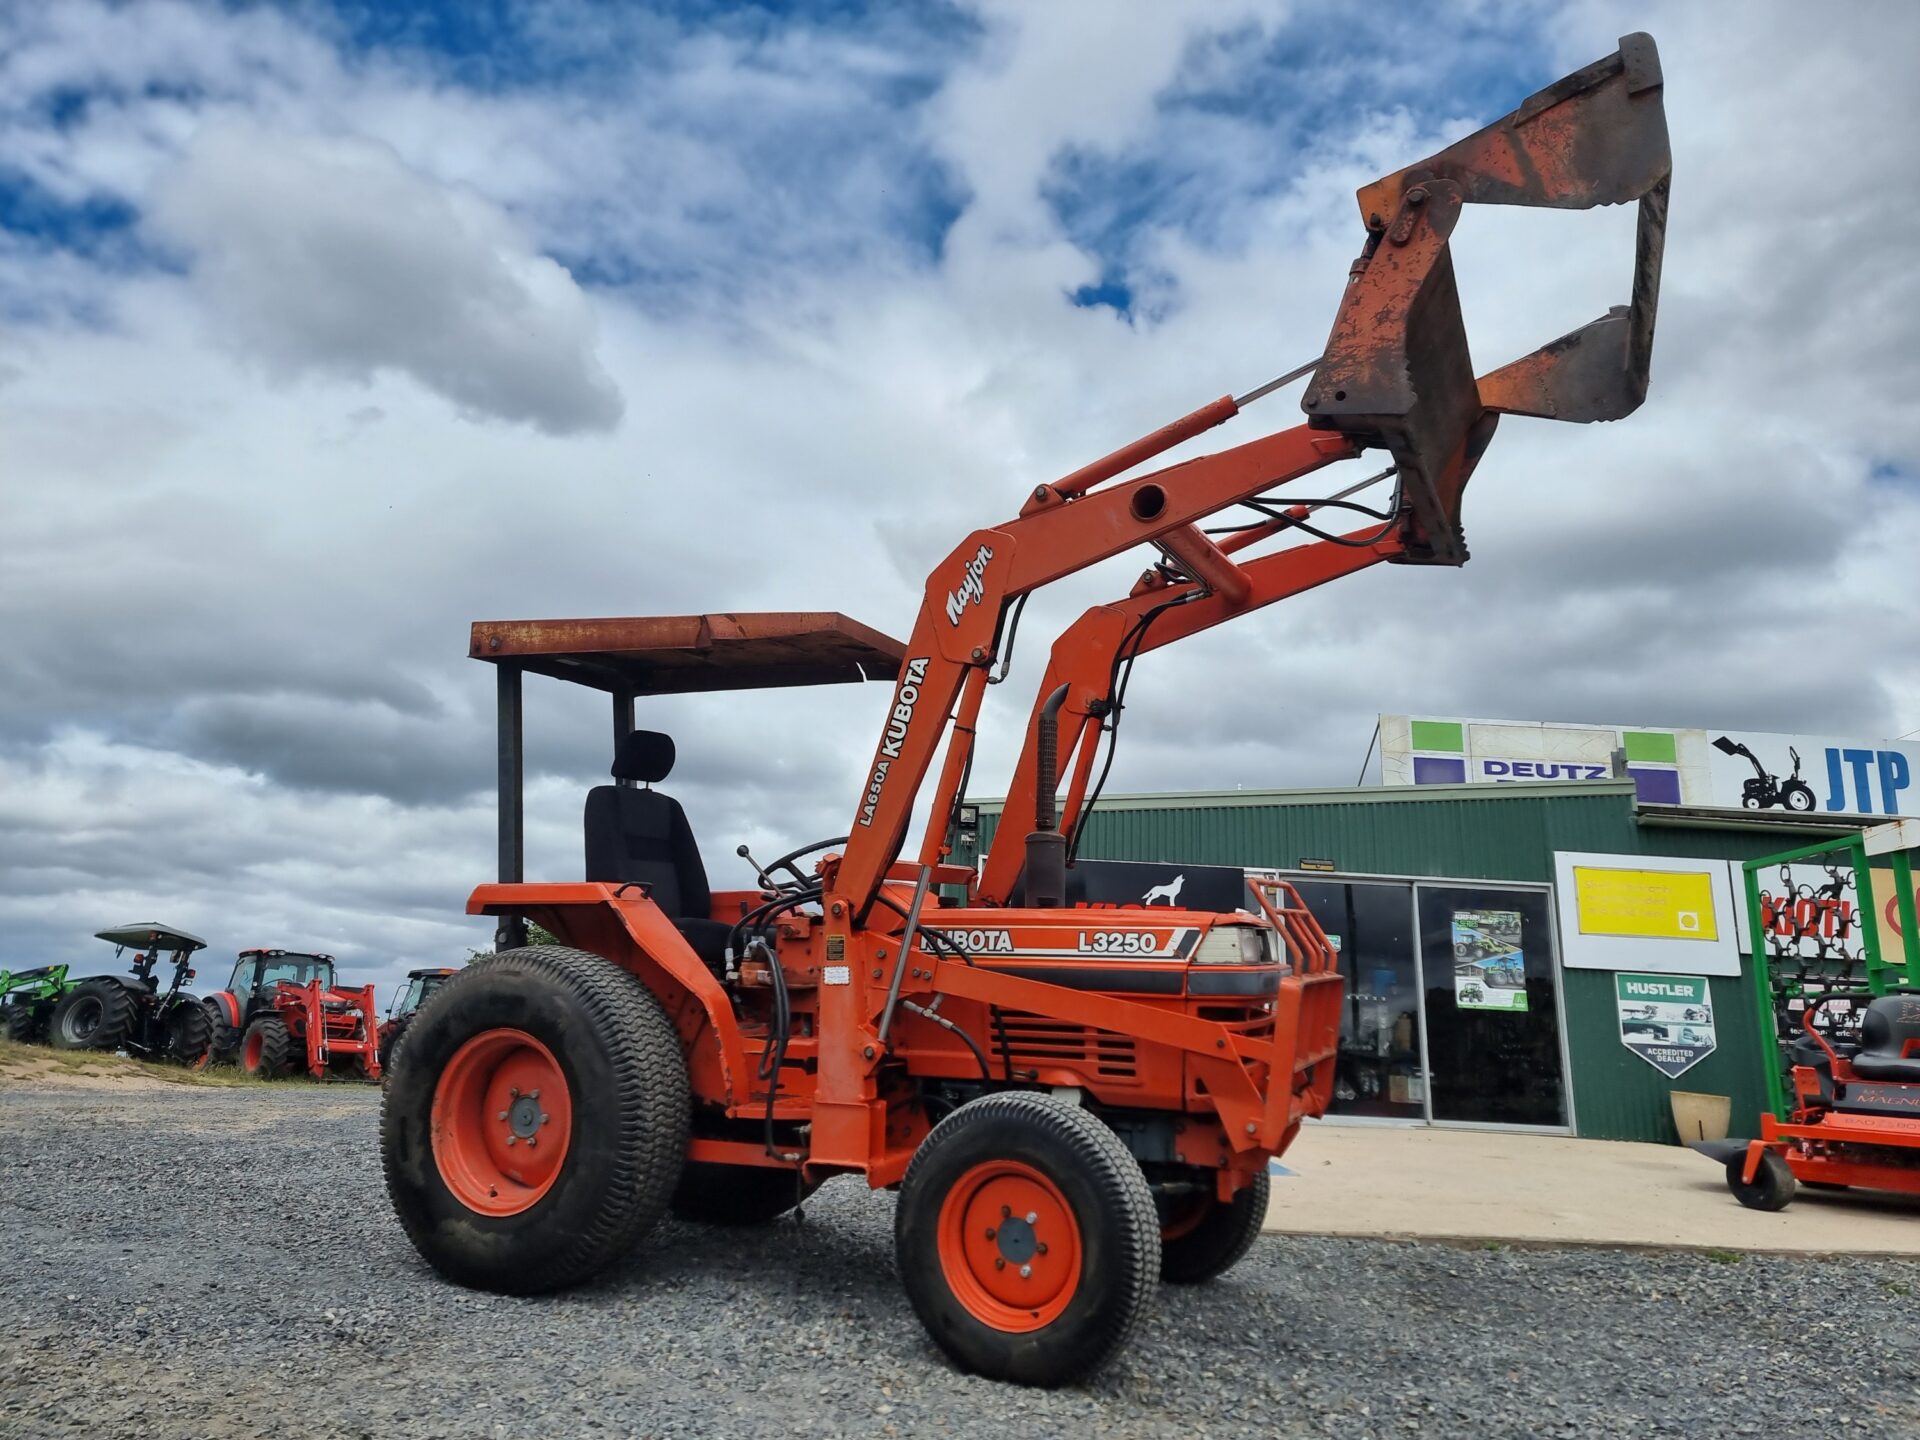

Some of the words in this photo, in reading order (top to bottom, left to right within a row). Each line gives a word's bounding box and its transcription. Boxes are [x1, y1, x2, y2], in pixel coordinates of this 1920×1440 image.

[858, 760, 890, 828] LA650A
[880, 656, 931, 759] KUBOTA
[1483, 760, 1608, 780] DEUTZ
[1824, 747, 1911, 816] JTP
[1761, 895, 1851, 939] KIOTI
[919, 928, 1014, 952] KUBOTA
[1077, 930, 1158, 954] L3250
[1626, 982, 1695, 997] HUSTLER
[1647, 1047, 1694, 1057] ACCREDITED
[1657, 1055, 1686, 1063] DEALER
